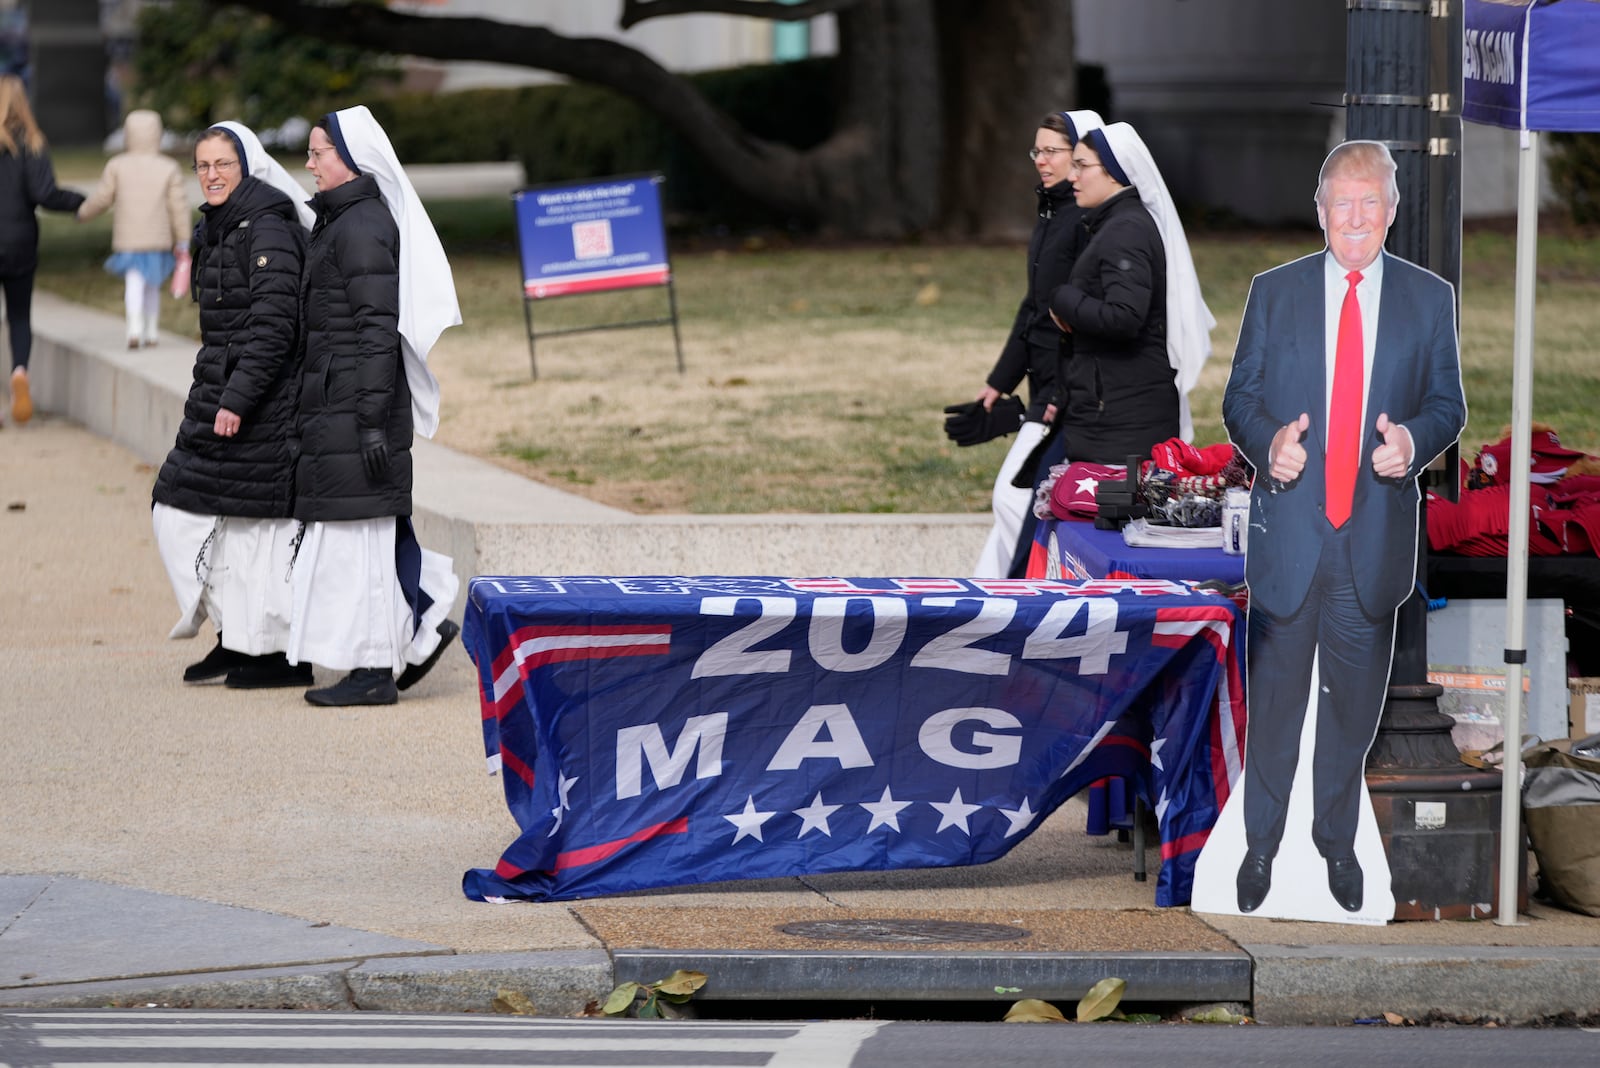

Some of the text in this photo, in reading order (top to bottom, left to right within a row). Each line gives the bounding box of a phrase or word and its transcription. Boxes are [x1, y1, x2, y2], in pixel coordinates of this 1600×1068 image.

[1480, 30, 1515, 85] AGAIN
[691, 596, 1129, 679] 2024
[616, 704, 1116, 801] MAG
